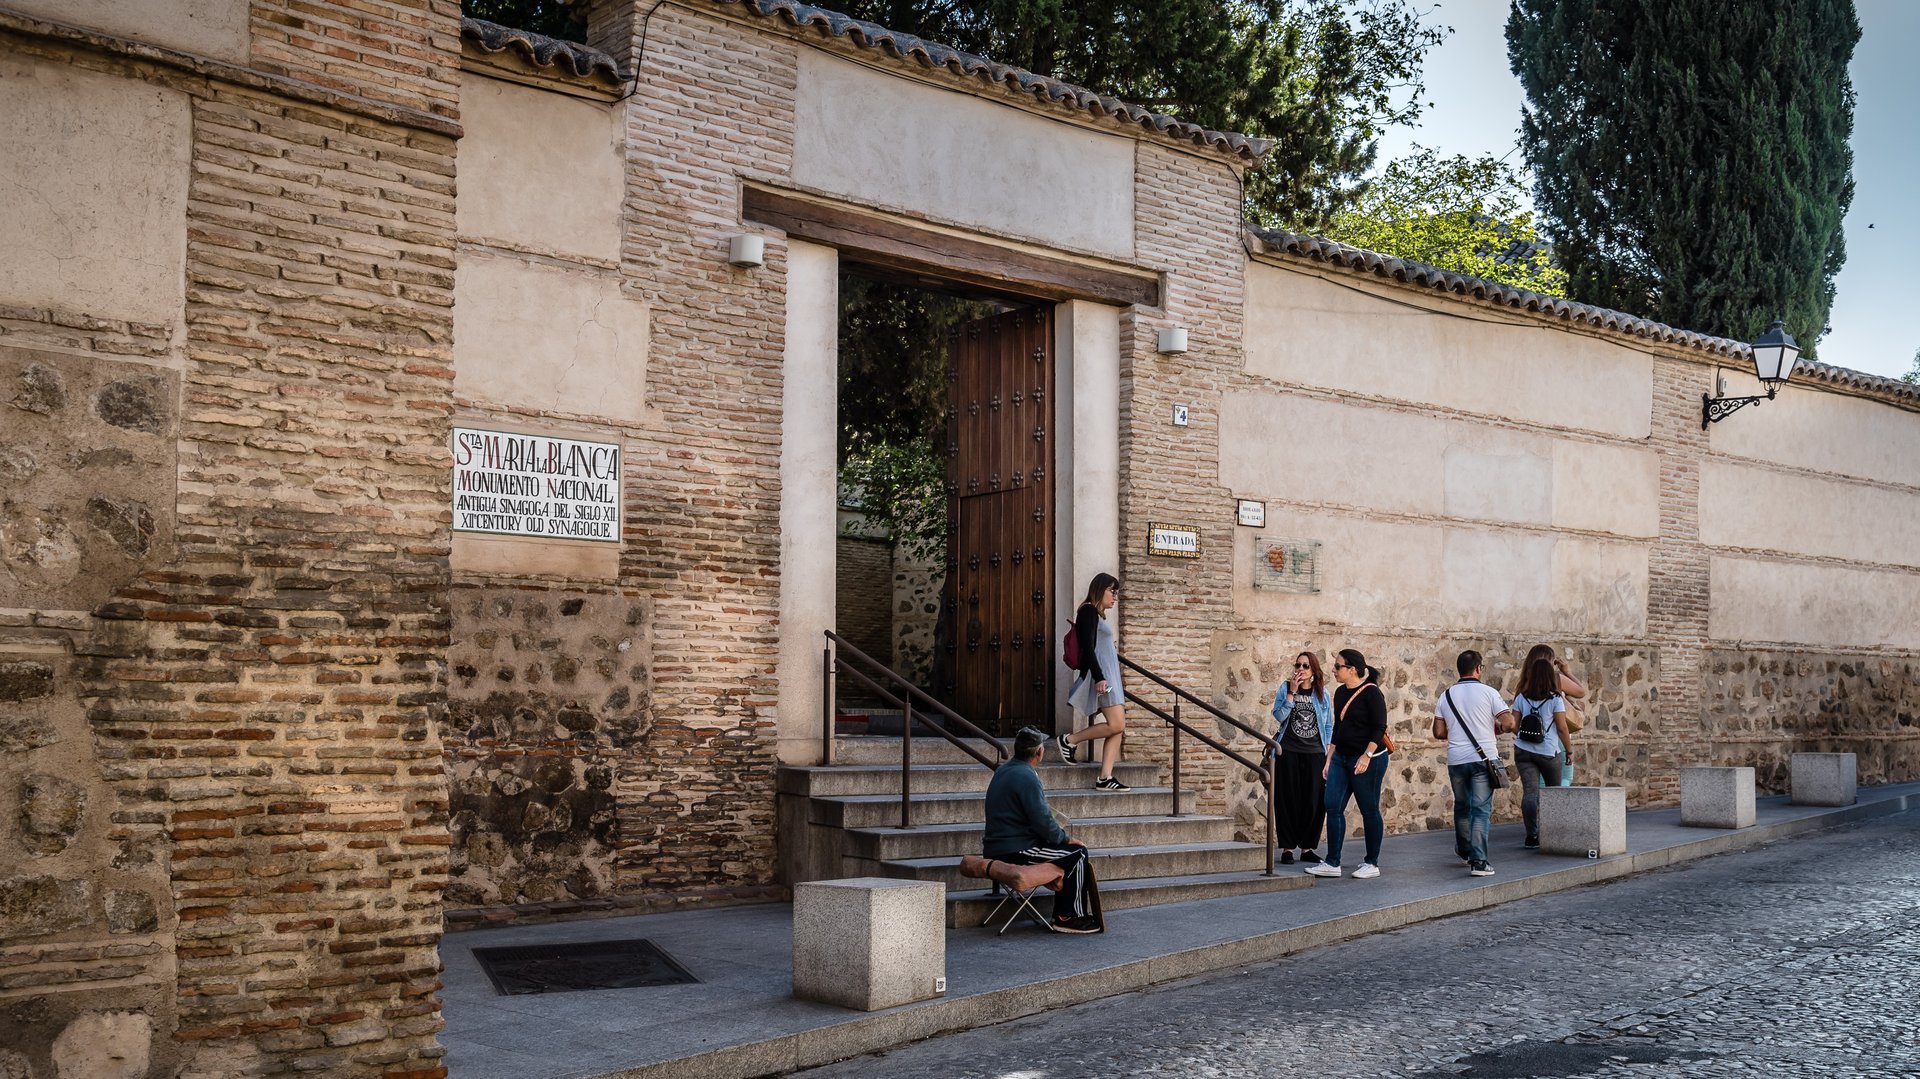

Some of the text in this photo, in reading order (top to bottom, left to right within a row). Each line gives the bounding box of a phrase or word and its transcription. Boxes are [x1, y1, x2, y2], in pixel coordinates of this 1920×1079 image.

[1180, 410, 1187, 422] 4
[481, 434, 537, 473] MARIA
[547, 441, 618, 481] BLANCA
[457, 469, 615, 504] MONUMENTO NACIONAL.
[456, 494, 497, 513] ANTIGUA
[499, 498, 549, 517] SINAGOGA
[554, 502, 571, 519] DEL
[574, 504, 601, 521] SIGLO
[526, 516, 544, 533] OLD
[1155, 533, 1195, 547] ENTRADA
